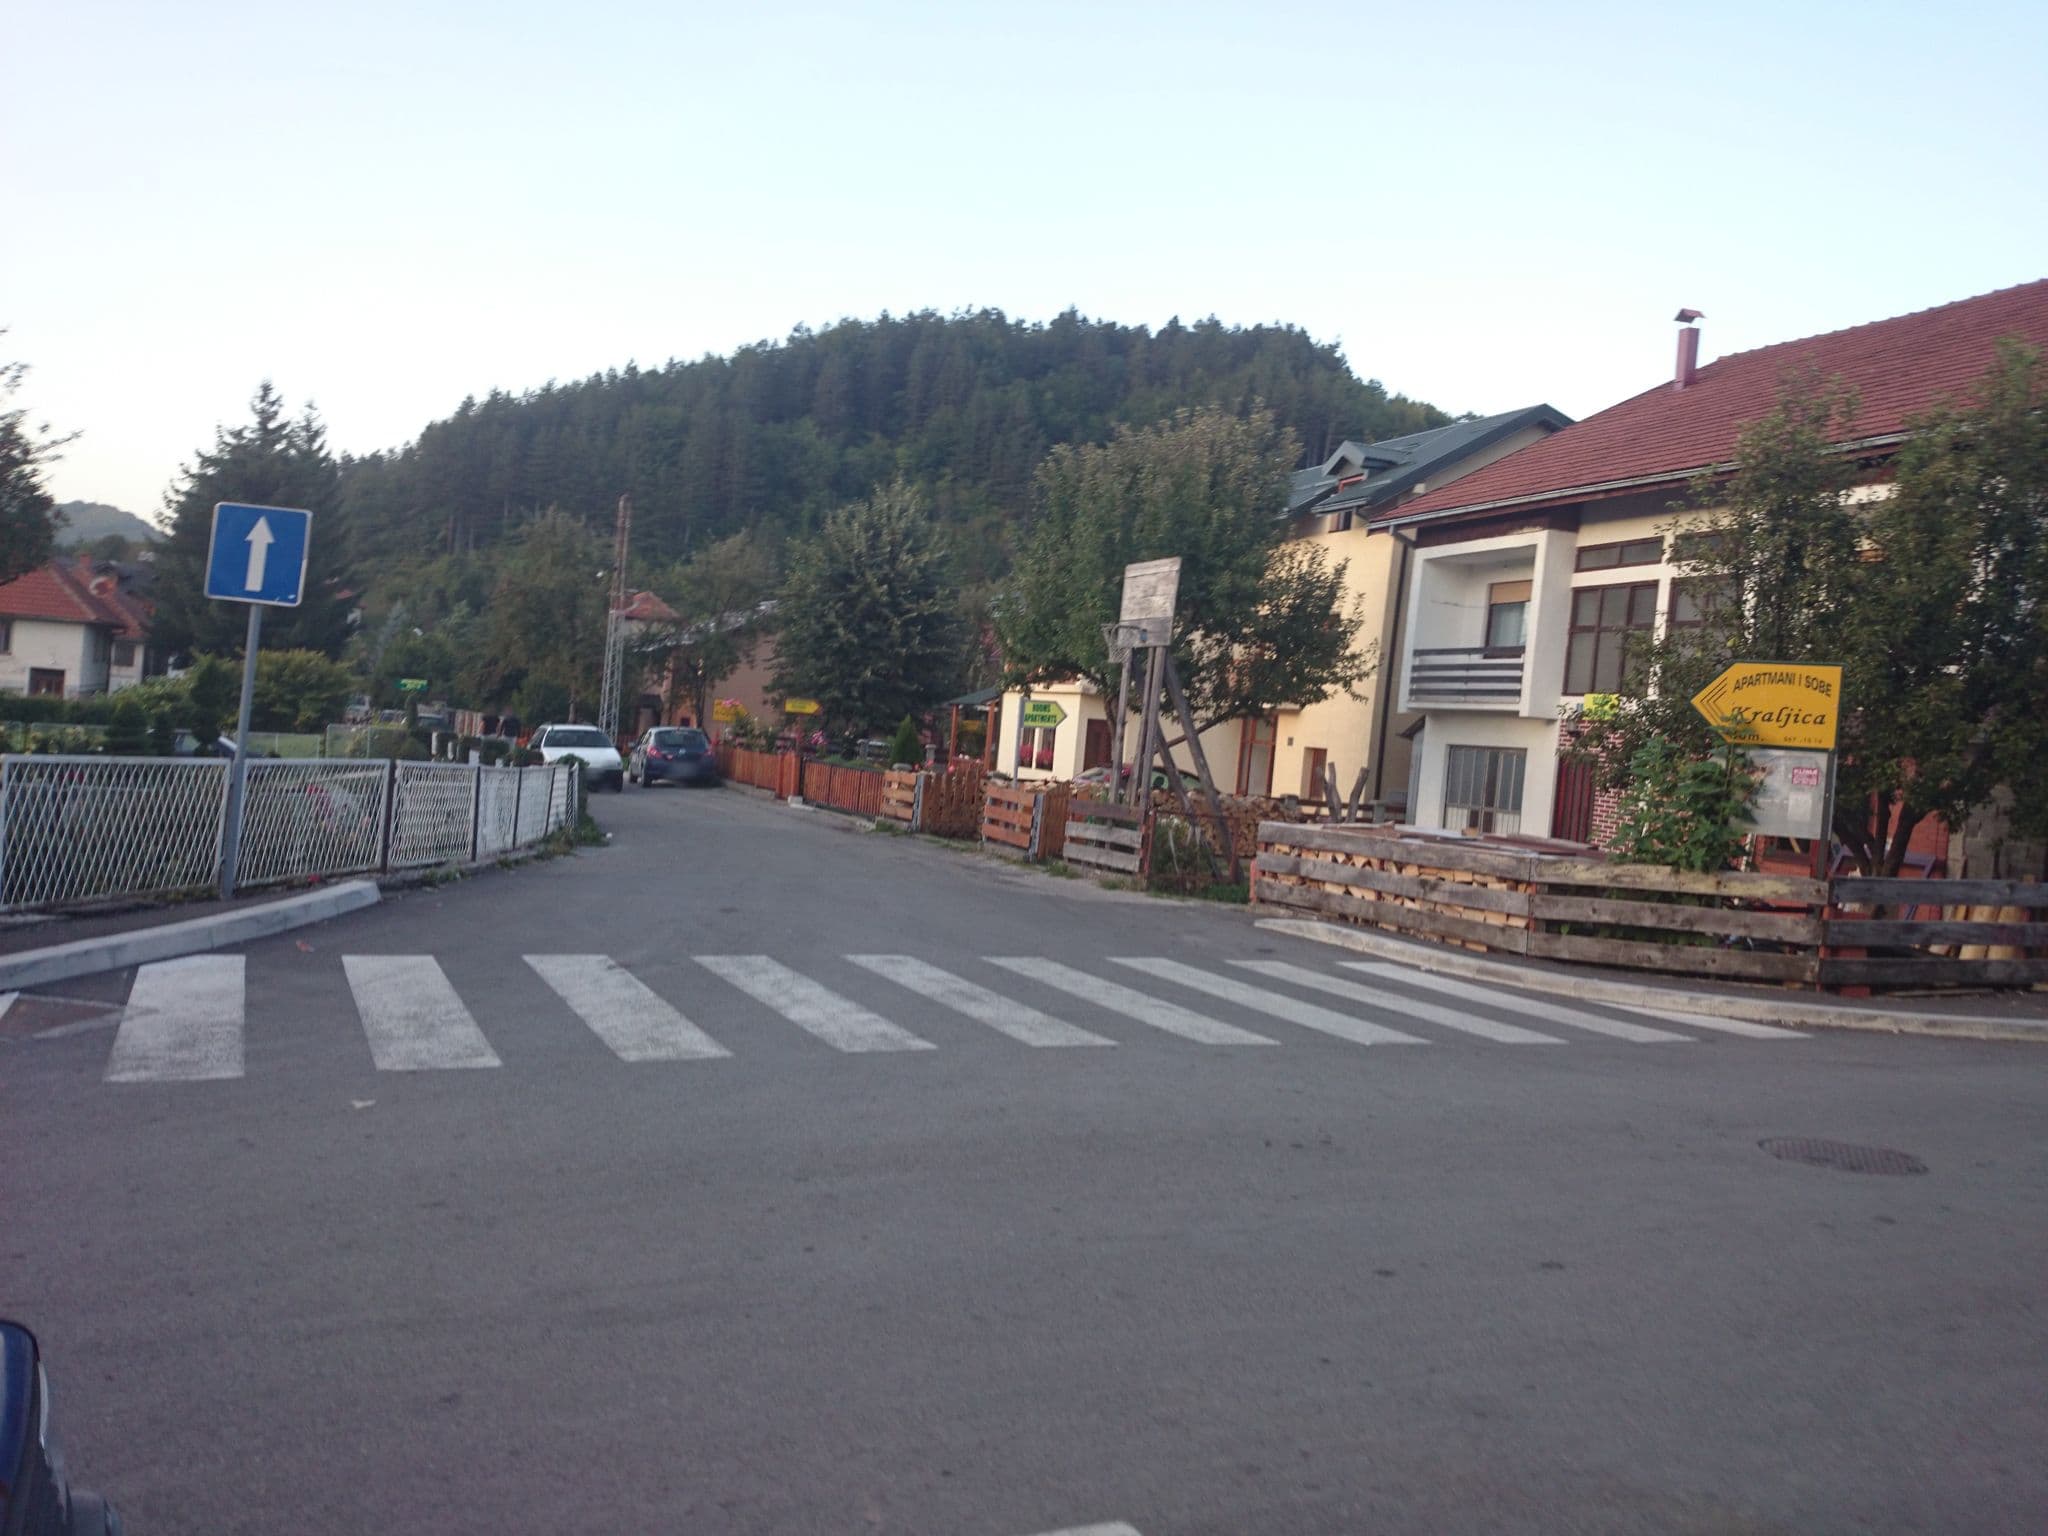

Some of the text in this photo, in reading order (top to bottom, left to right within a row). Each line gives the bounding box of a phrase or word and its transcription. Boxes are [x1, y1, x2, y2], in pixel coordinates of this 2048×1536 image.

[1733, 672, 1832, 697] APARTMANI I SOBE
[1730, 706, 1826, 728] Kraljica
